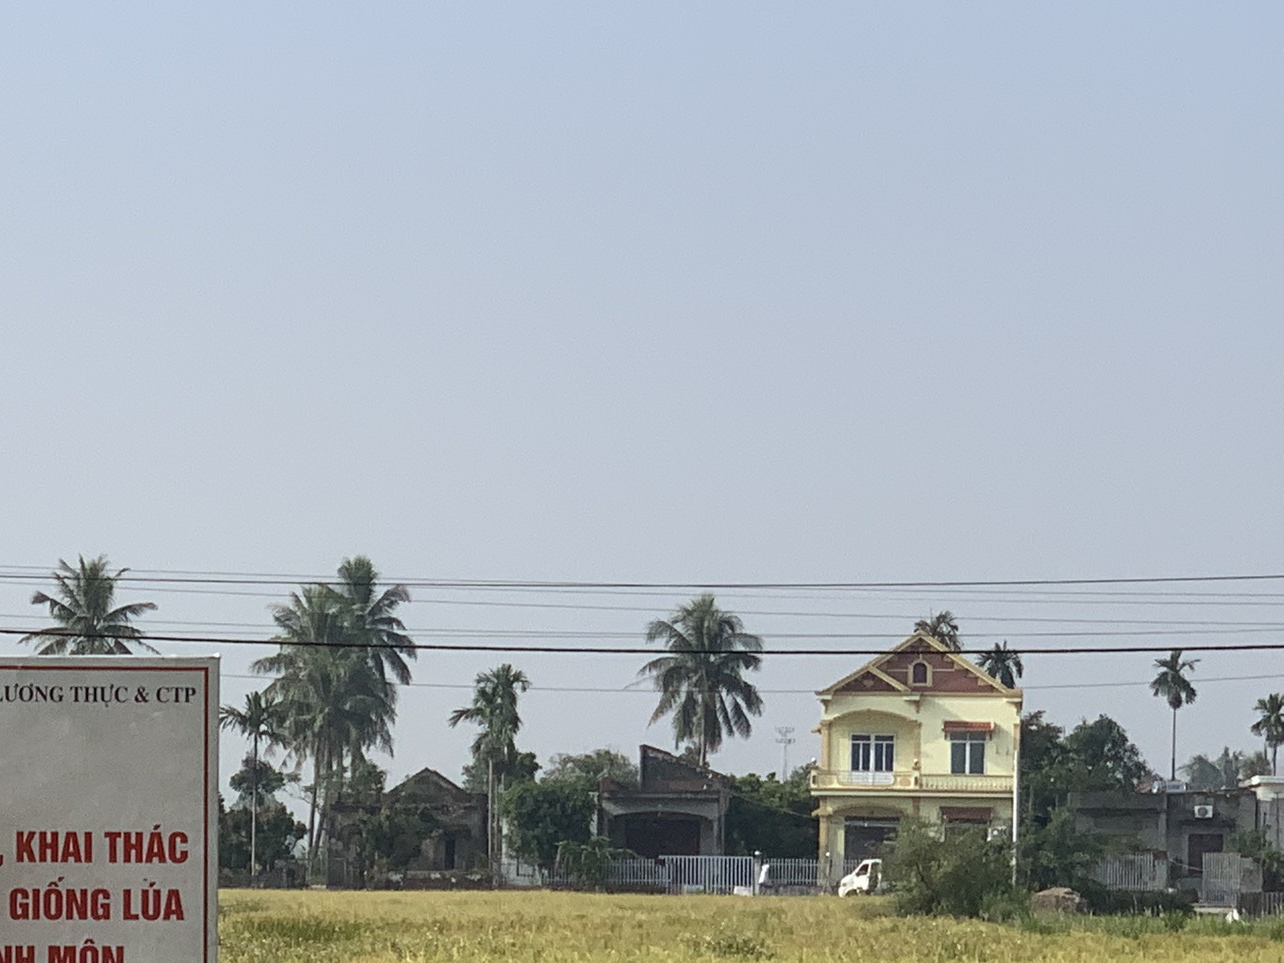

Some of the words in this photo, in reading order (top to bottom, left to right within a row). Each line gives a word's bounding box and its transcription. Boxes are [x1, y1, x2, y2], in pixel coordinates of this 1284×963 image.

[70, 684, 128, 708] THỰC
[135, 687, 149, 703] &
[156, 687, 196, 703] CTP
[16, 831, 92, 863] KHAI
[104, 824, 188, 863] THÁC
[10, 876, 110, 920] GIỐNG
[123, 881, 184, 920] LÚA
